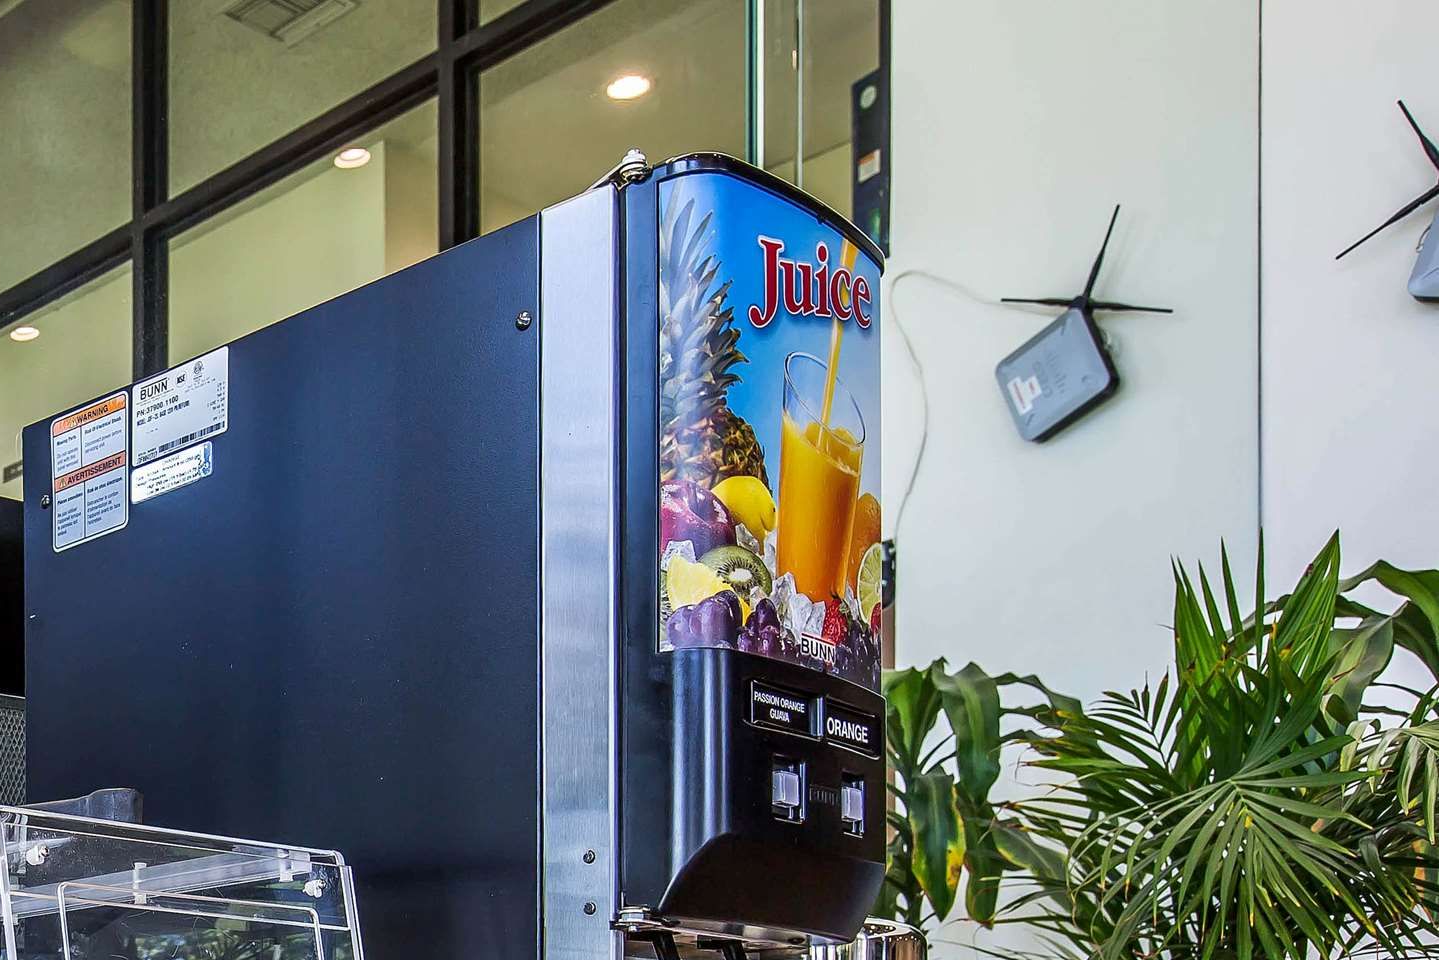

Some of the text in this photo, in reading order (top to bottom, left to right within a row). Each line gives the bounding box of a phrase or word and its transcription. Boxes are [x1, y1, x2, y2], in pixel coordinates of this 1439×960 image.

[748, 235, 873, 328] Juice
[140, 379, 168, 401] BUNN
[76, 404, 109, 424] WARNING
[67, 457, 122, 485] AVERTISSEMENT
[800, 637, 837, 664] BUNN
[753, 690, 805, 714] PASSION ORANGE
[769, 708, 790, 723] GUAVA
[826, 716, 869, 744] ORANGE
